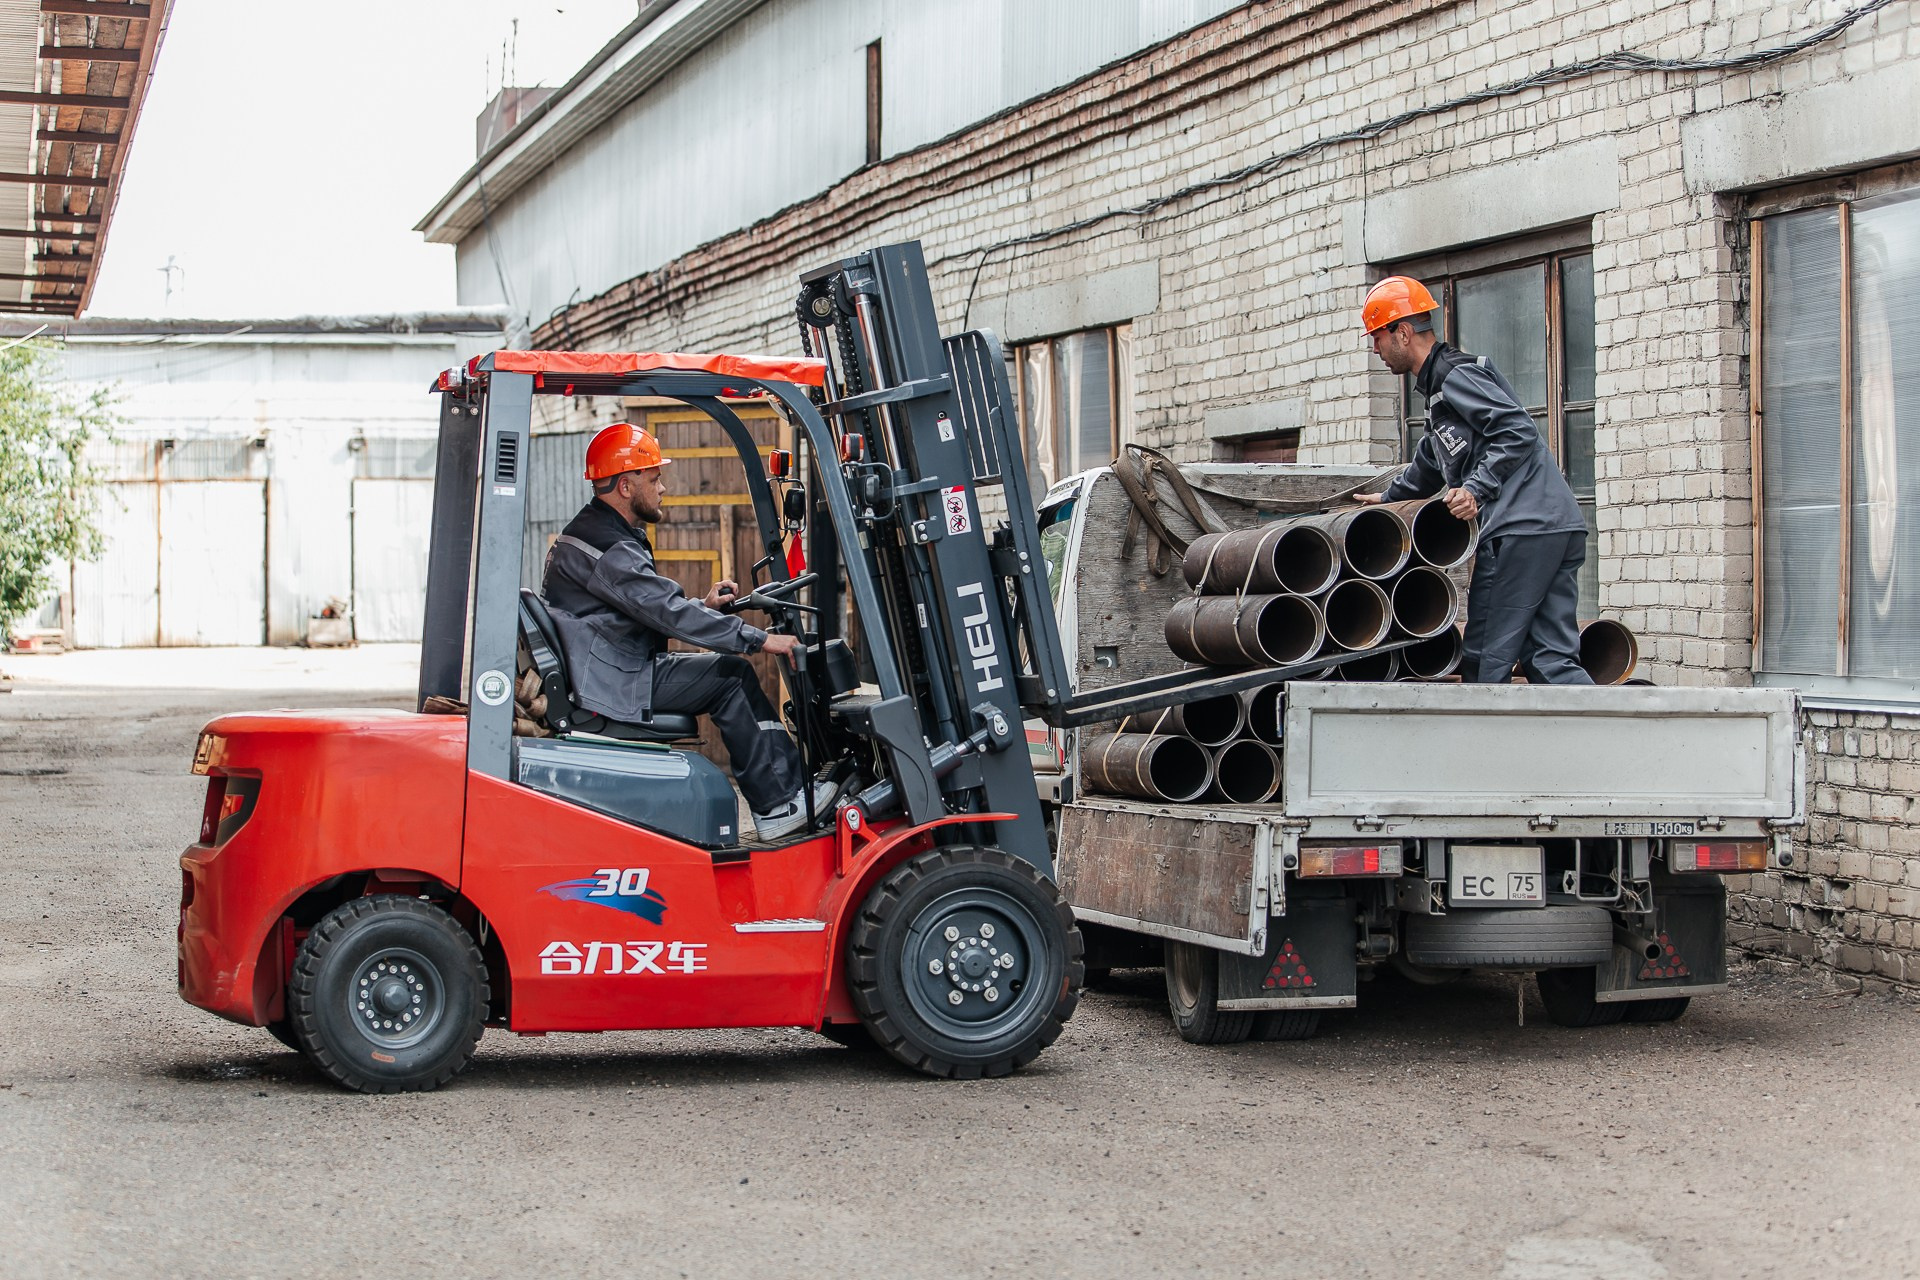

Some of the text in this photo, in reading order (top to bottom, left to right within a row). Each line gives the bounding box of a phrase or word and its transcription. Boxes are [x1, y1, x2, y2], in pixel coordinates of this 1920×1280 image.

[956, 582, 1004, 692] HELI
[587, 867, 650, 897] 30
[1462, 876, 1534, 897] EC 75
[538, 941, 708, 975] 合力叉车
